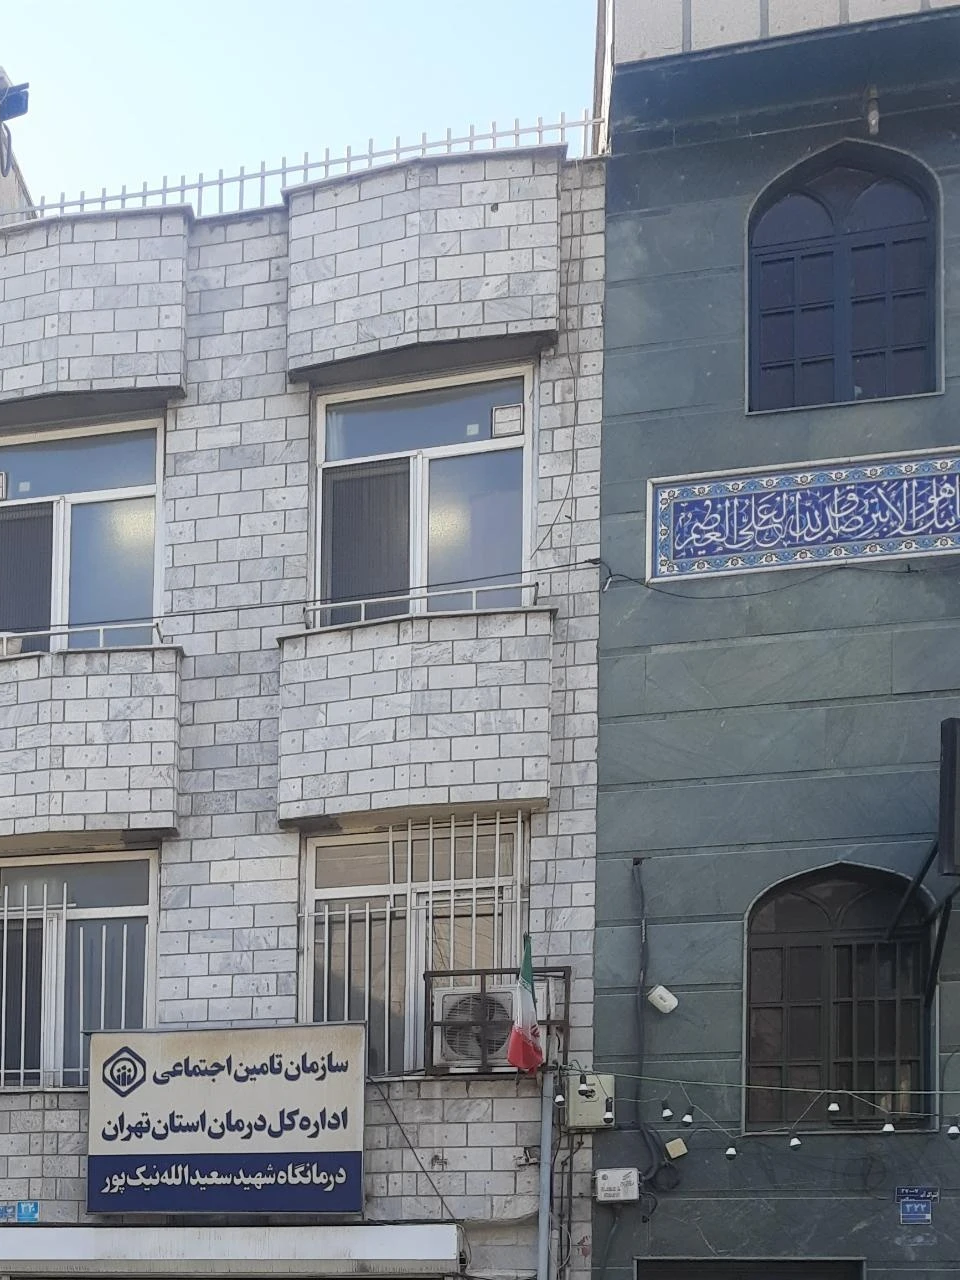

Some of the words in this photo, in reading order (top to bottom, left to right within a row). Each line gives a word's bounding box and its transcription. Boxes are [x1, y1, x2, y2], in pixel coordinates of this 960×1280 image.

[152, 1054, 233, 1085] اجتماعی
[233, 1053, 283, 1082] تامین
[285, 1052, 349, 1081] سازمان
[101, 1112, 151, 1141] تهران
[151, 1110, 206, 1141] استان
[207, 1108, 267, 1140] درمان
[267, 1109, 299, 1138] کل
[299, 1106, 348, 1138] اداره
[233, 1164, 277, 1190] شهید
[278, 1163, 347, 1191] درمانگاه
